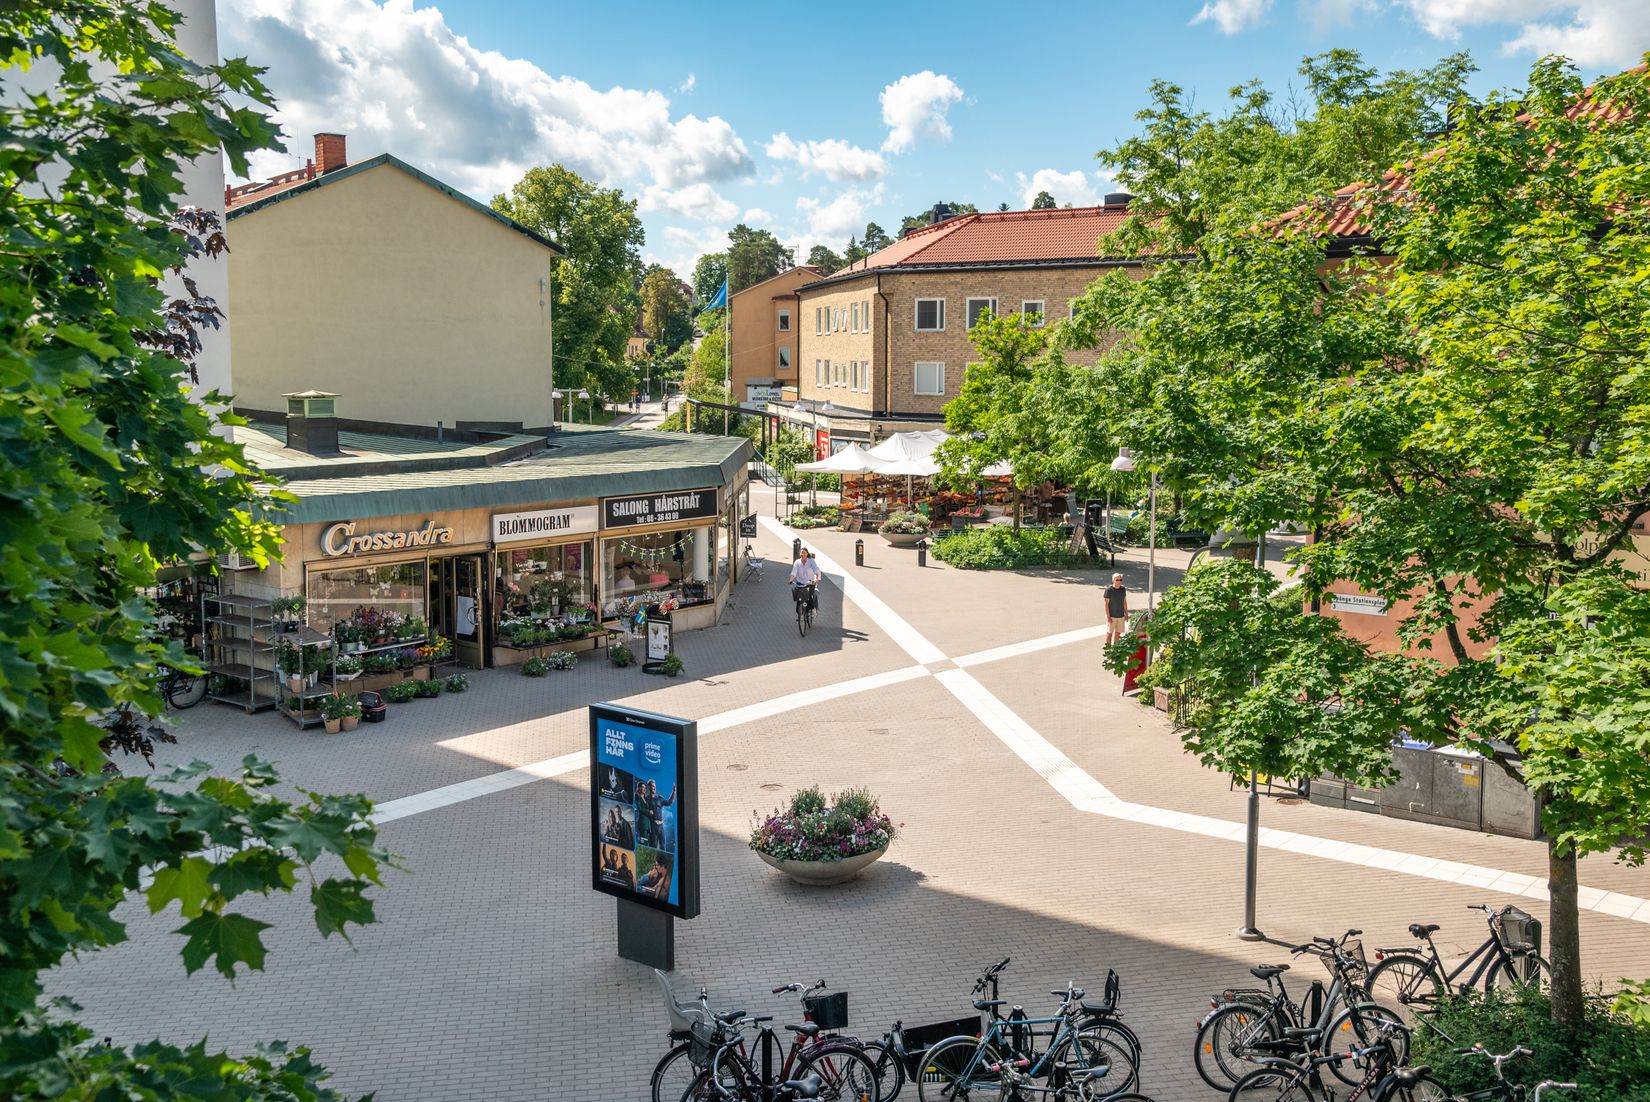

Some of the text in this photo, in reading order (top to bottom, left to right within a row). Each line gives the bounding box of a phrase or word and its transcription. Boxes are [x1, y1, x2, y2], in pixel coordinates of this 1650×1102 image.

[612, 492, 701, 517] SALONG HÅRSTRÅT
[321, 520, 454, 556] Crossandra
[1334, 595, 1386, 607] pånga Stationsplan
[605, 728, 626, 740] ALLT
[605, 737, 635, 751] FINNS
[644, 742, 661, 751] prime
[644, 749, 661, 758] video
